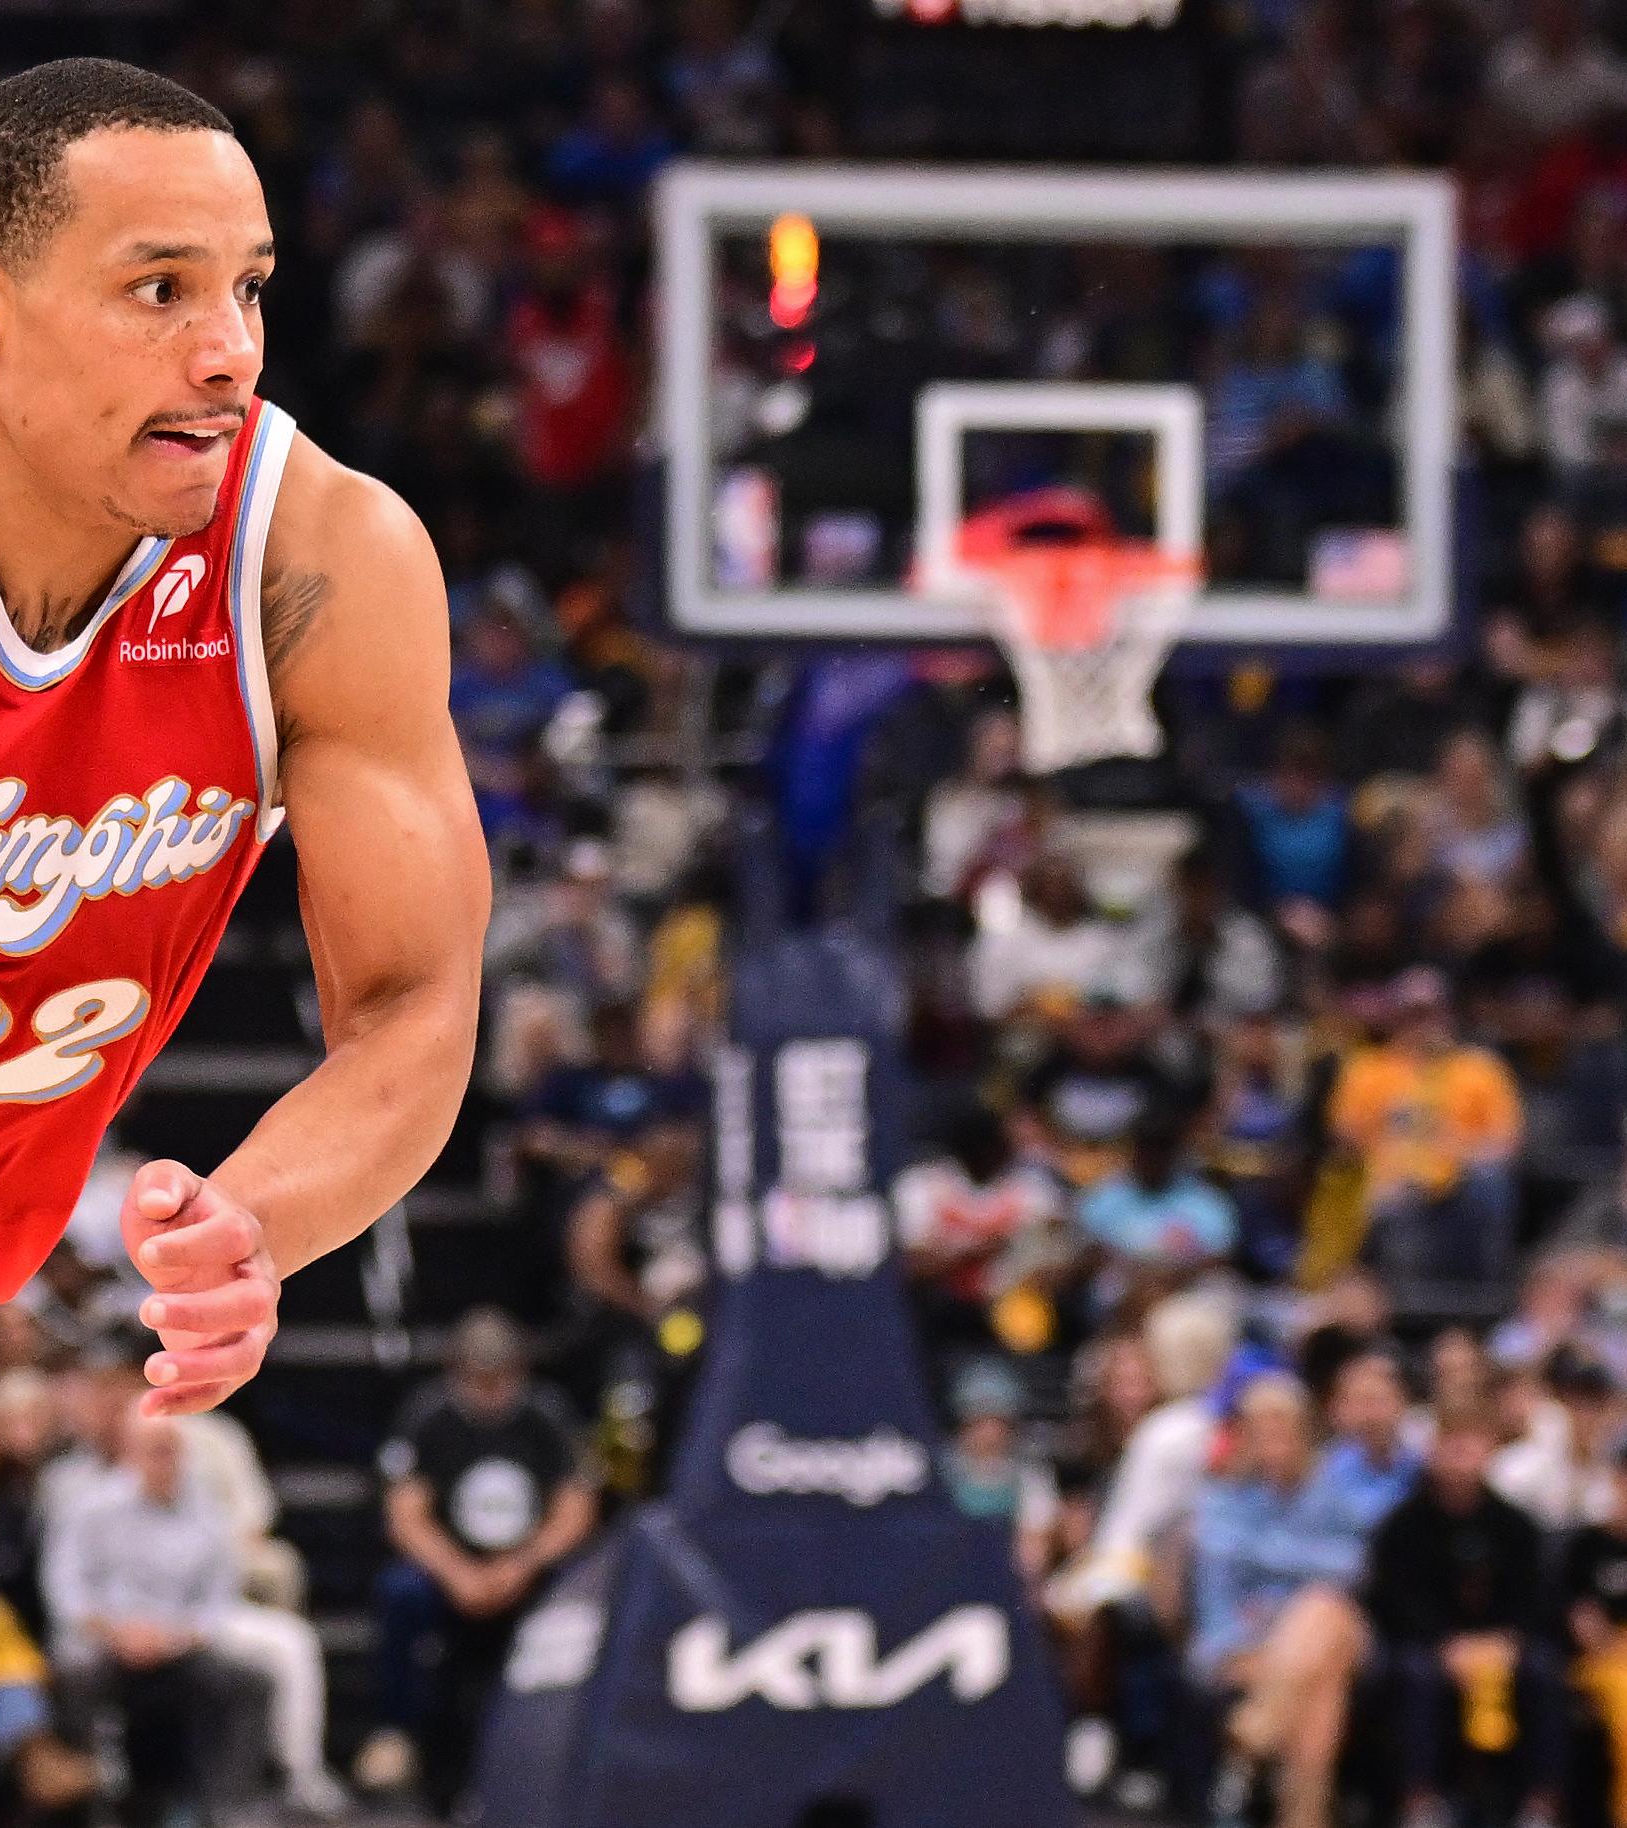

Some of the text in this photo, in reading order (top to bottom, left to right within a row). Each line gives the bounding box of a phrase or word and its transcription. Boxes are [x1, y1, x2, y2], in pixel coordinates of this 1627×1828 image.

[119, 633, 232, 663] Robinhood
[724, 1422, 930, 1505] Google
[667, 1602, 1012, 1713] KIA
